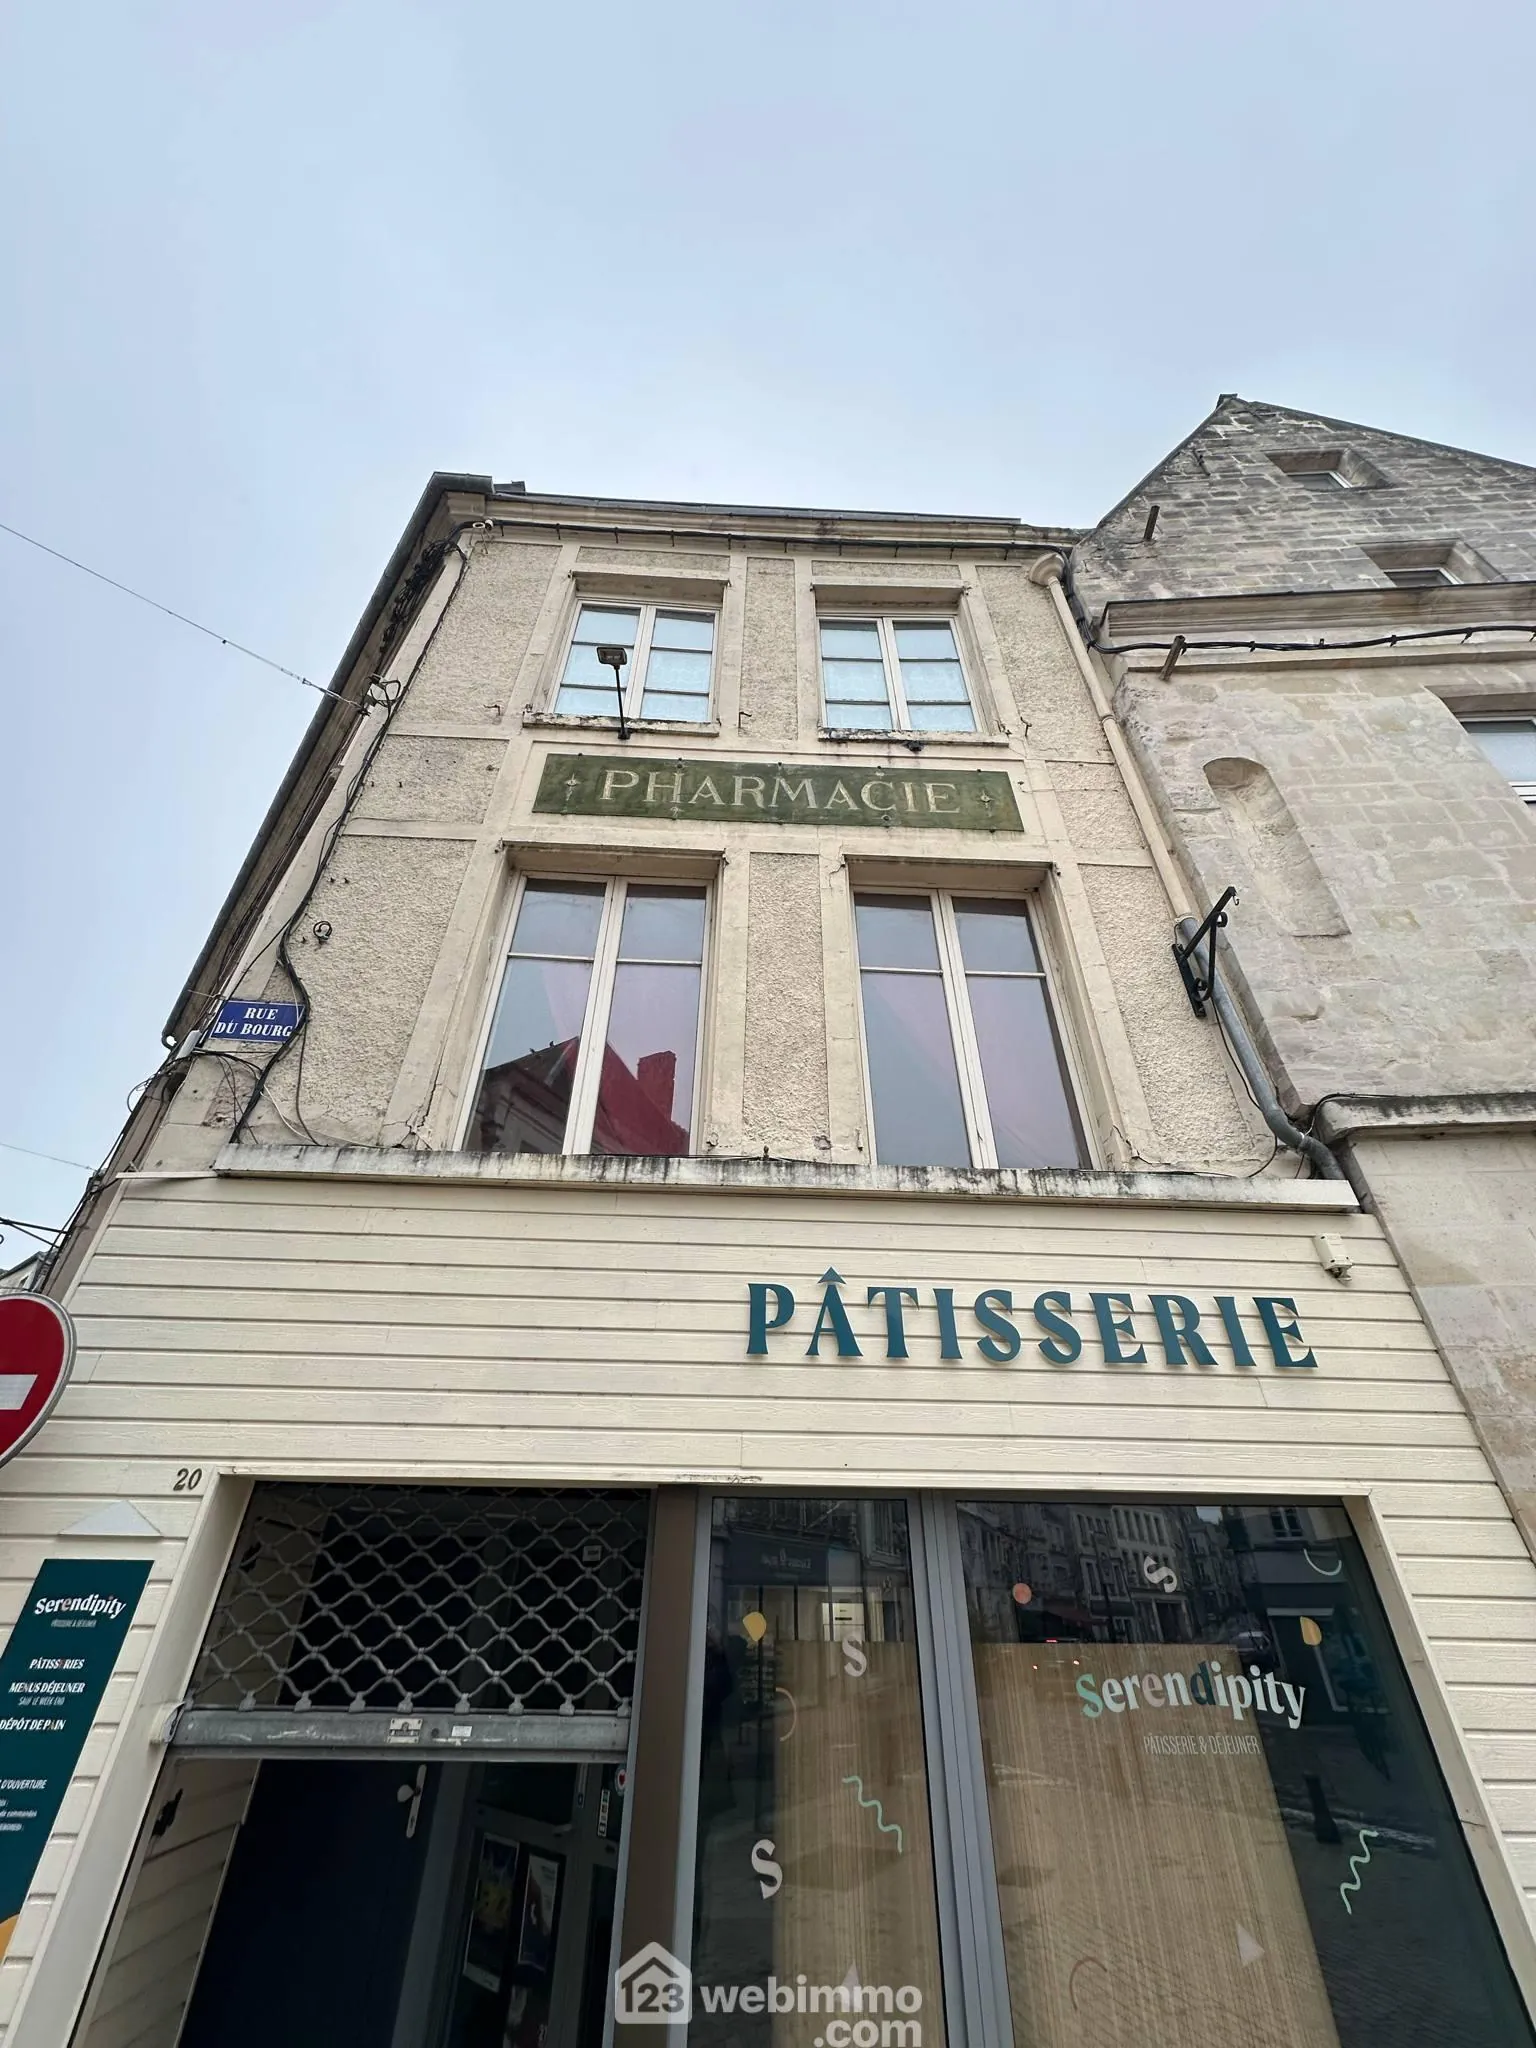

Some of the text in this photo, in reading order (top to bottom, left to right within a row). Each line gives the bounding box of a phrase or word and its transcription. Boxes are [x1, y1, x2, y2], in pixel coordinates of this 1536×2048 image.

[600, 769, 961, 813] PHARMACIE
[244, 1007, 278, 1020] RUE
[214, 1021, 293, 1037] DU BOURG
[746, 1266, 1319, 1367] PÂTISSERIE
[173, 1468, 203, 1491] 20
[34, 1593, 127, 1619] Serendipity
[8, 1680, 86, 1695] MENUS DÉJEUNER
[1075, 1661, 1306, 1729] Serendipity
[29, 1719, 44, 1730] DE
[1143, 1732, 1260, 1755] PÂTISSERIE & DÉJEUNER
